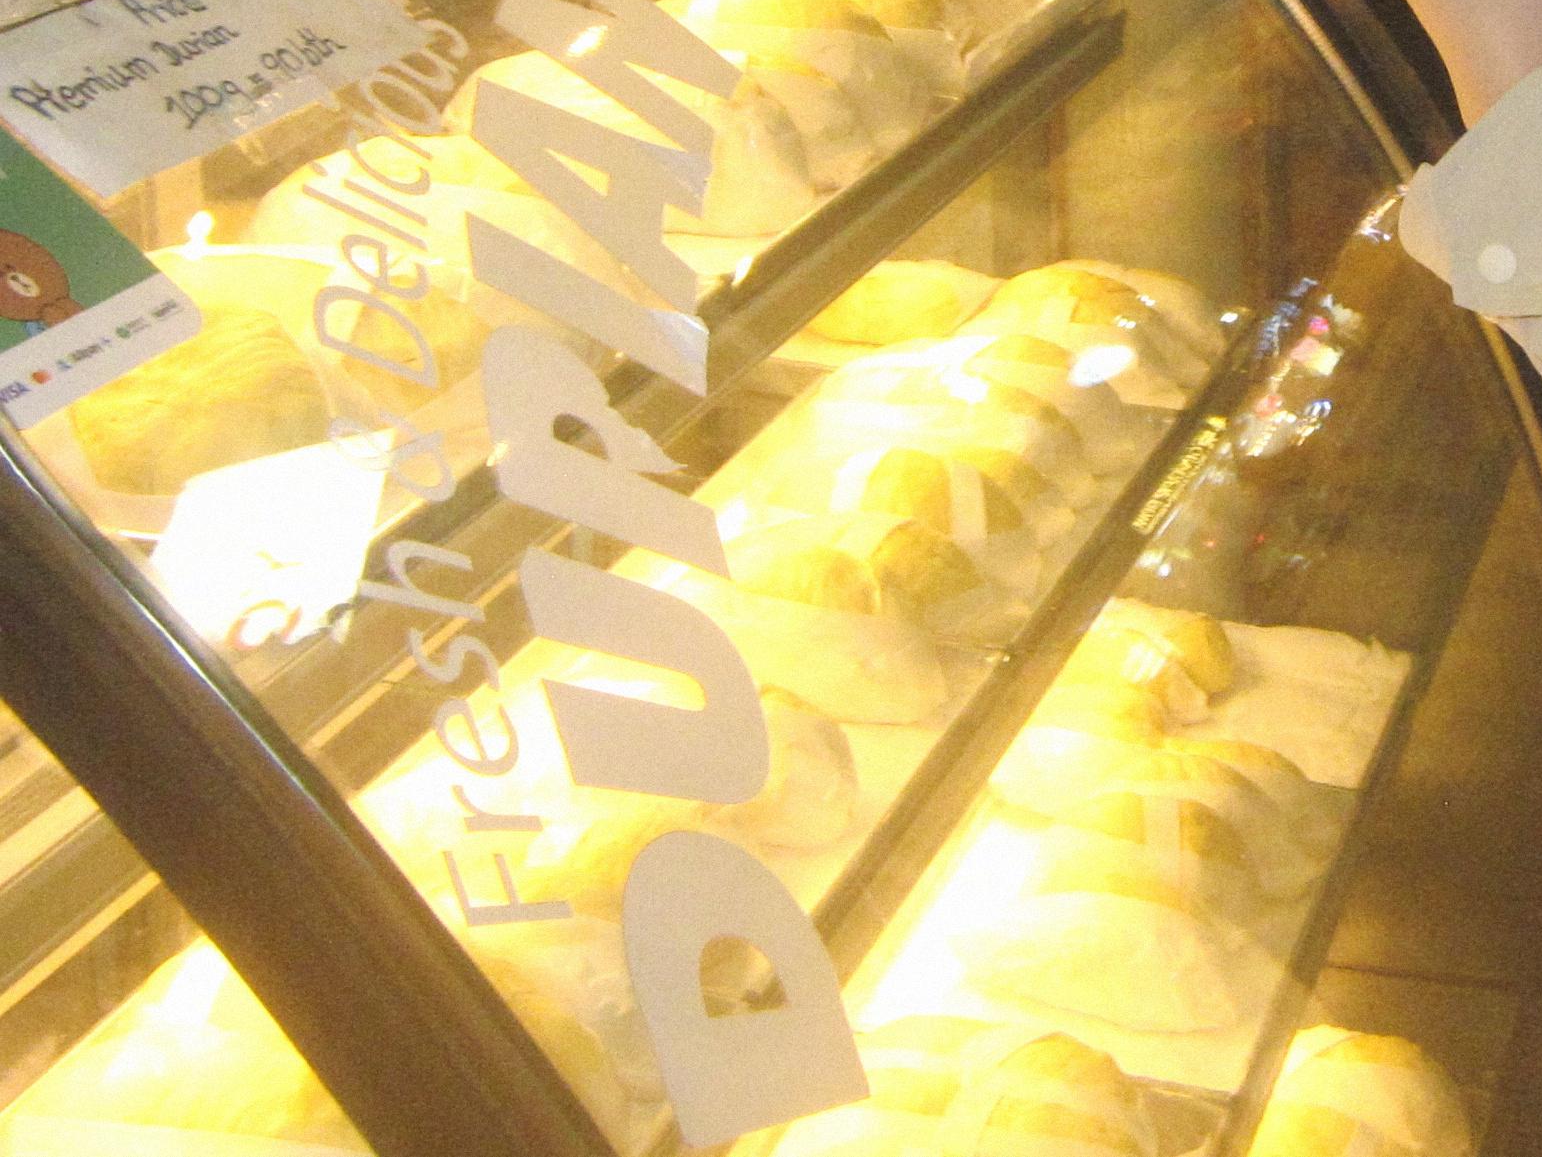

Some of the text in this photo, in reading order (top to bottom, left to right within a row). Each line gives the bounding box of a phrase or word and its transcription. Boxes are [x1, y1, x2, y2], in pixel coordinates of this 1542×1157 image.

[9, 66, 160, 120] Premium
[302, 18, 469, 389] Delicious
[359, 540, 574, 927] Fresh
